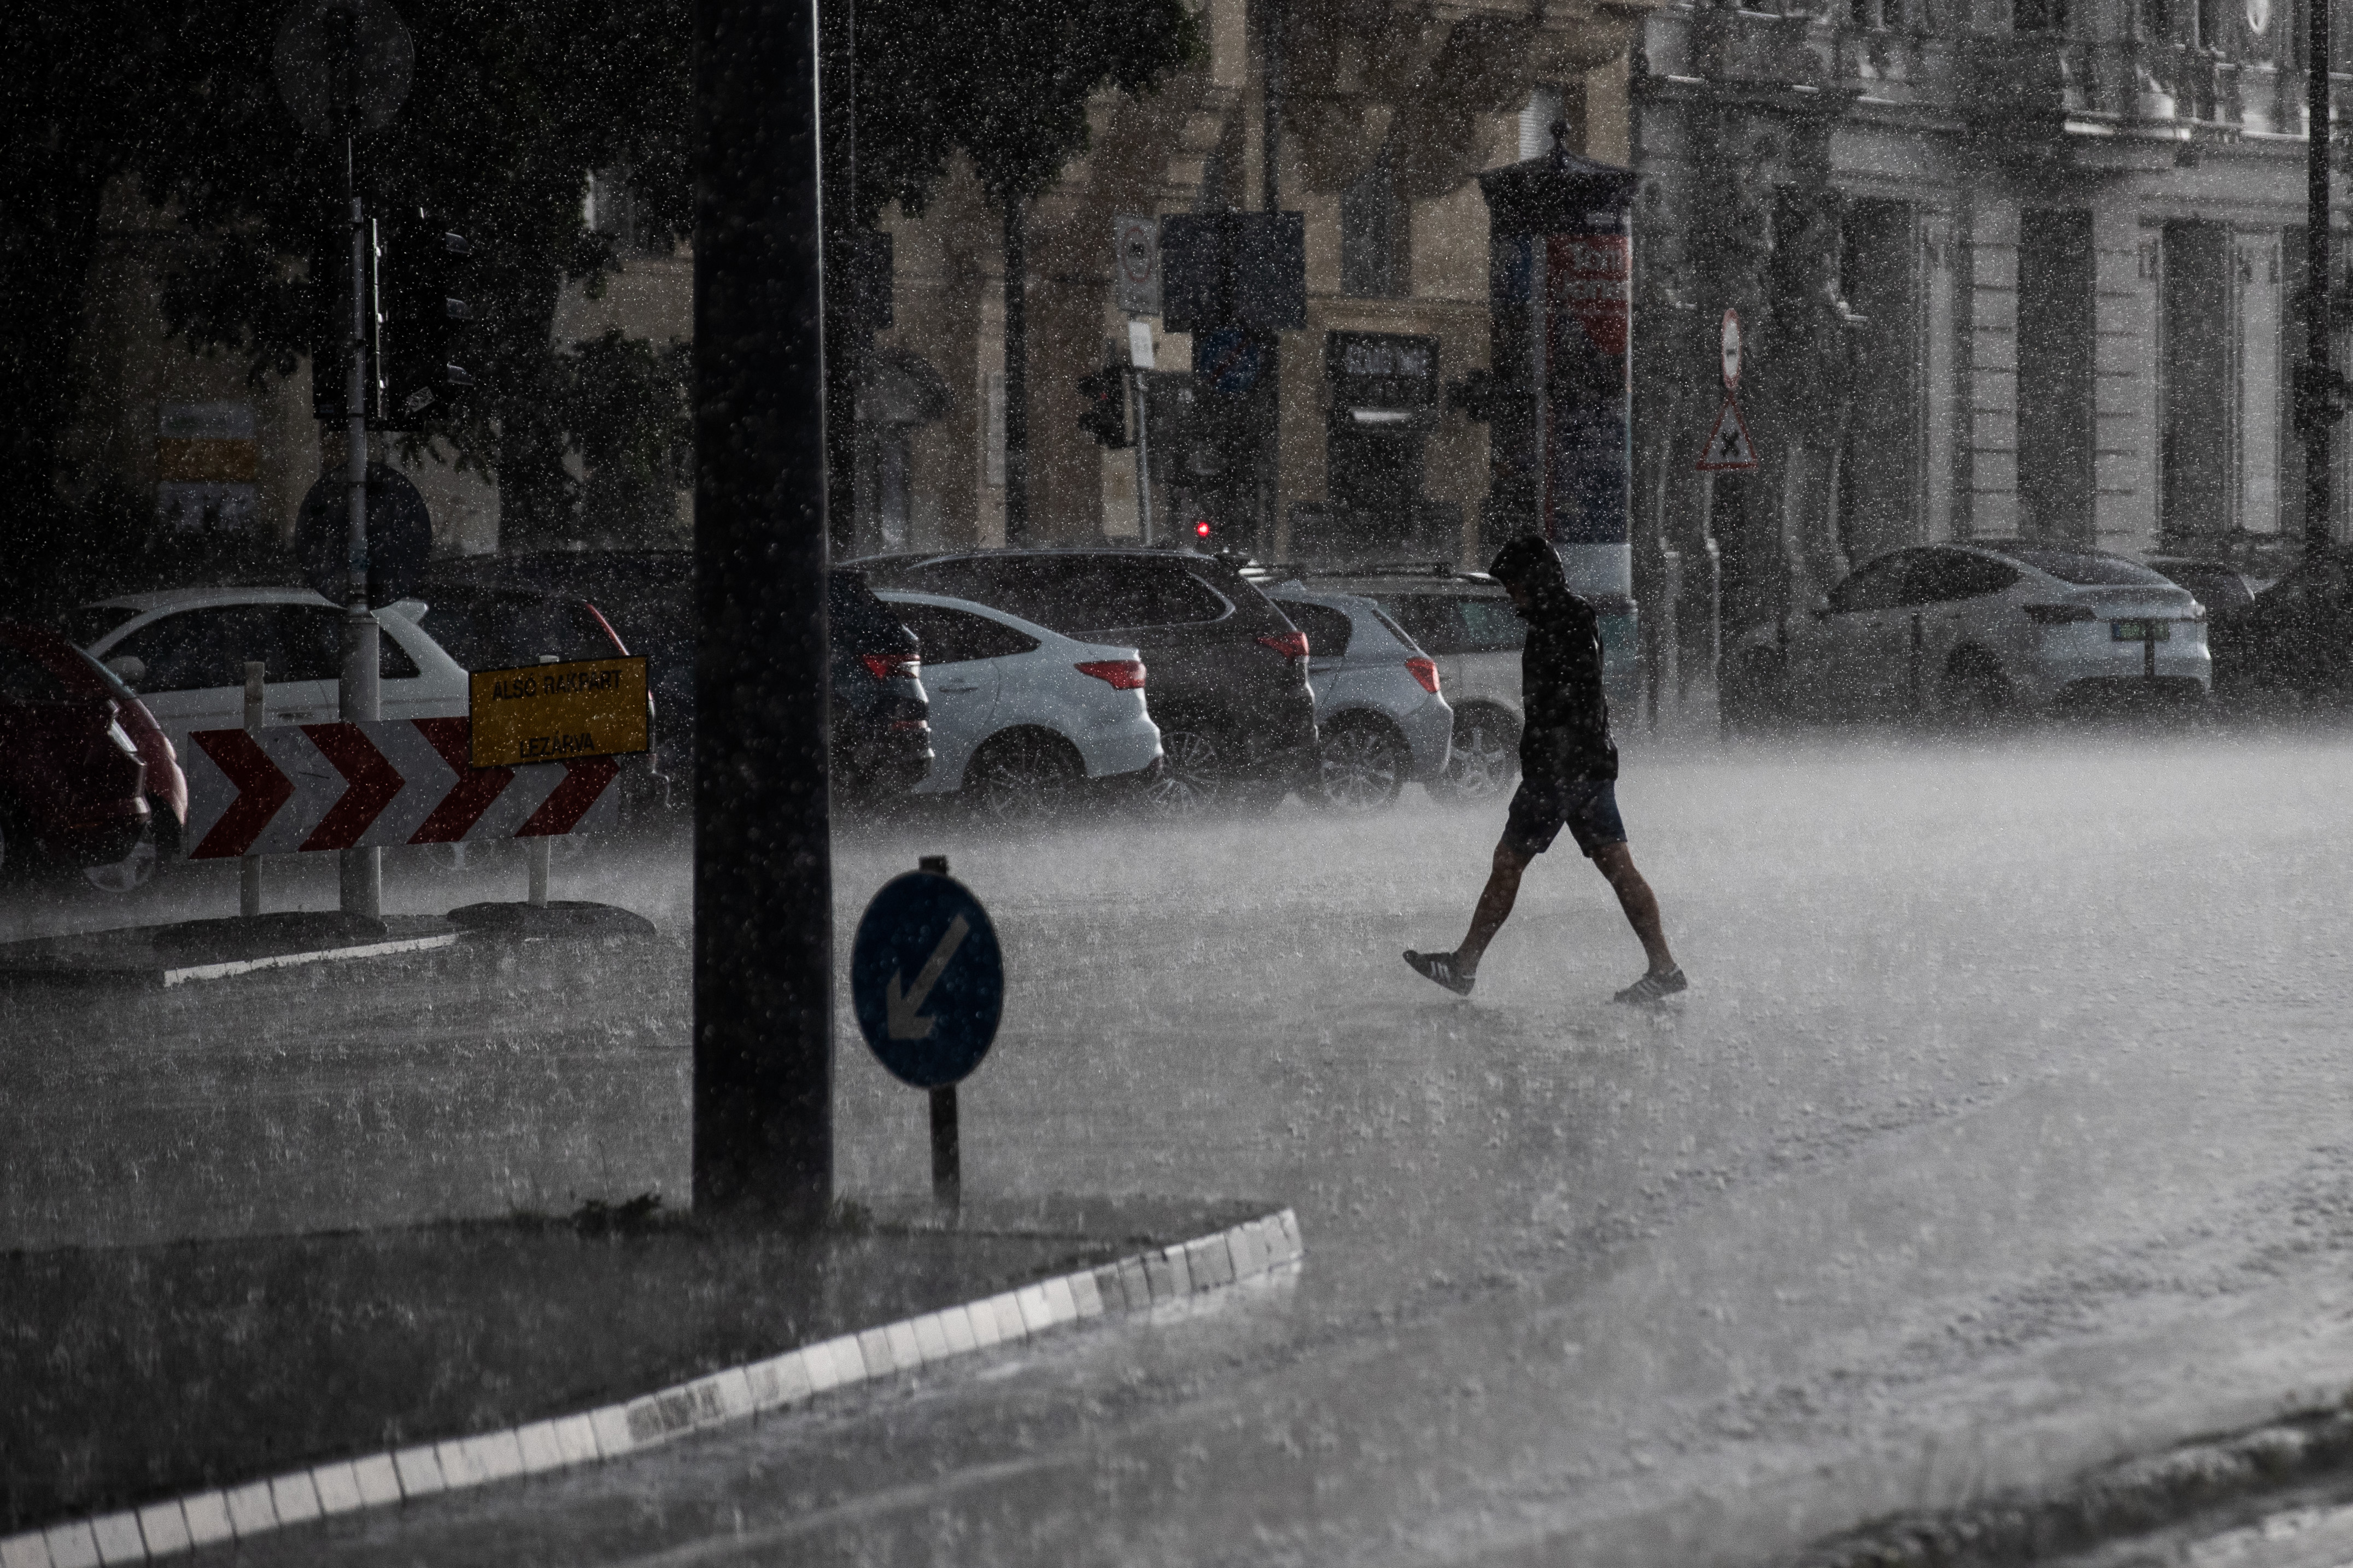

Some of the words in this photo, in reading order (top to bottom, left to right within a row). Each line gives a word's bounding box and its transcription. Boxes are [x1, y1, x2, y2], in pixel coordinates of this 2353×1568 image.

[493, 674, 537, 700] ALSÓ
[544, 671, 623, 695] RAKPART
[519, 731, 594, 758] LEZÁRVA
